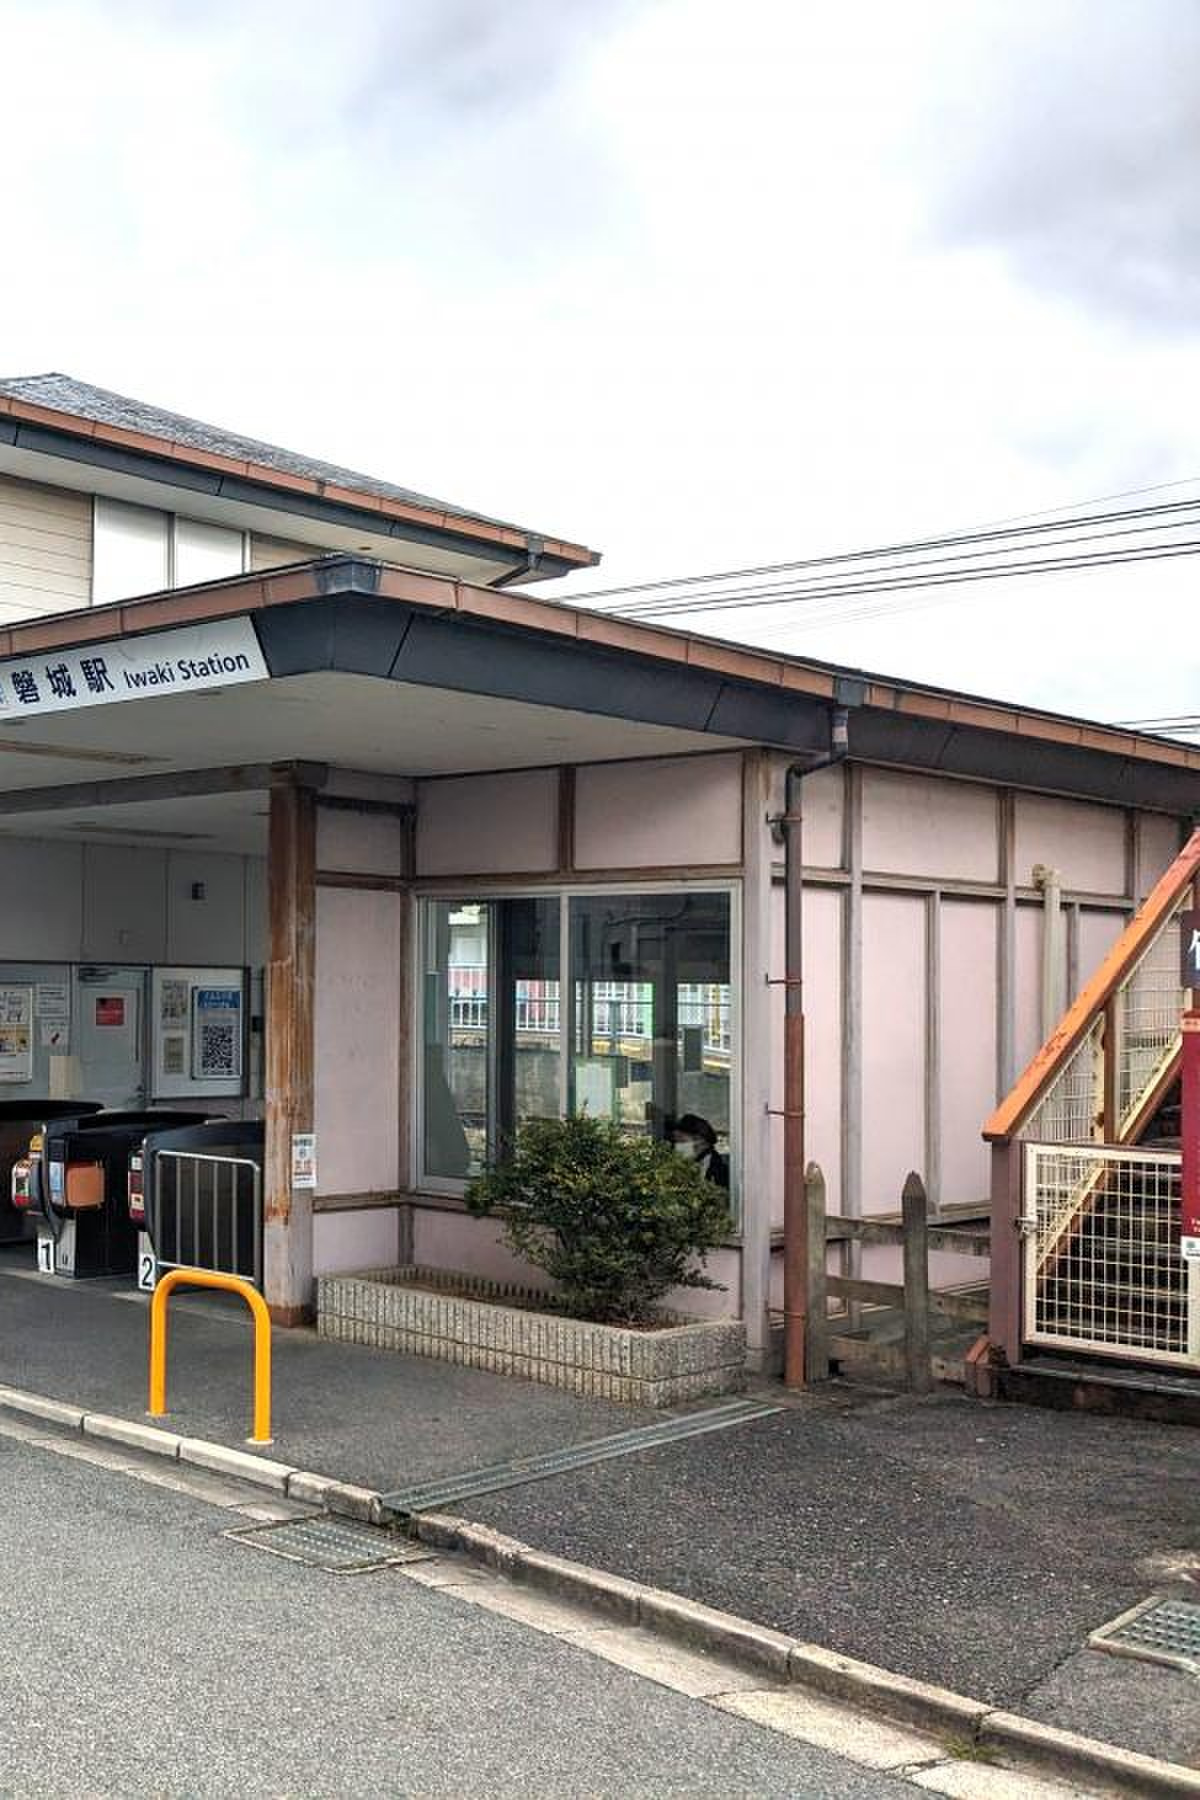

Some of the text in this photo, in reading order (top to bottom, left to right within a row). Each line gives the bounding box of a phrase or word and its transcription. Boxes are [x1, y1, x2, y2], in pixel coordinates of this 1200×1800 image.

[11, 657, 115, 704] 磐城駅
[124, 653, 250, 688] Iwaki Station
[41, 1242, 51, 1270] 1
[142, 1256, 153, 1287] 2
